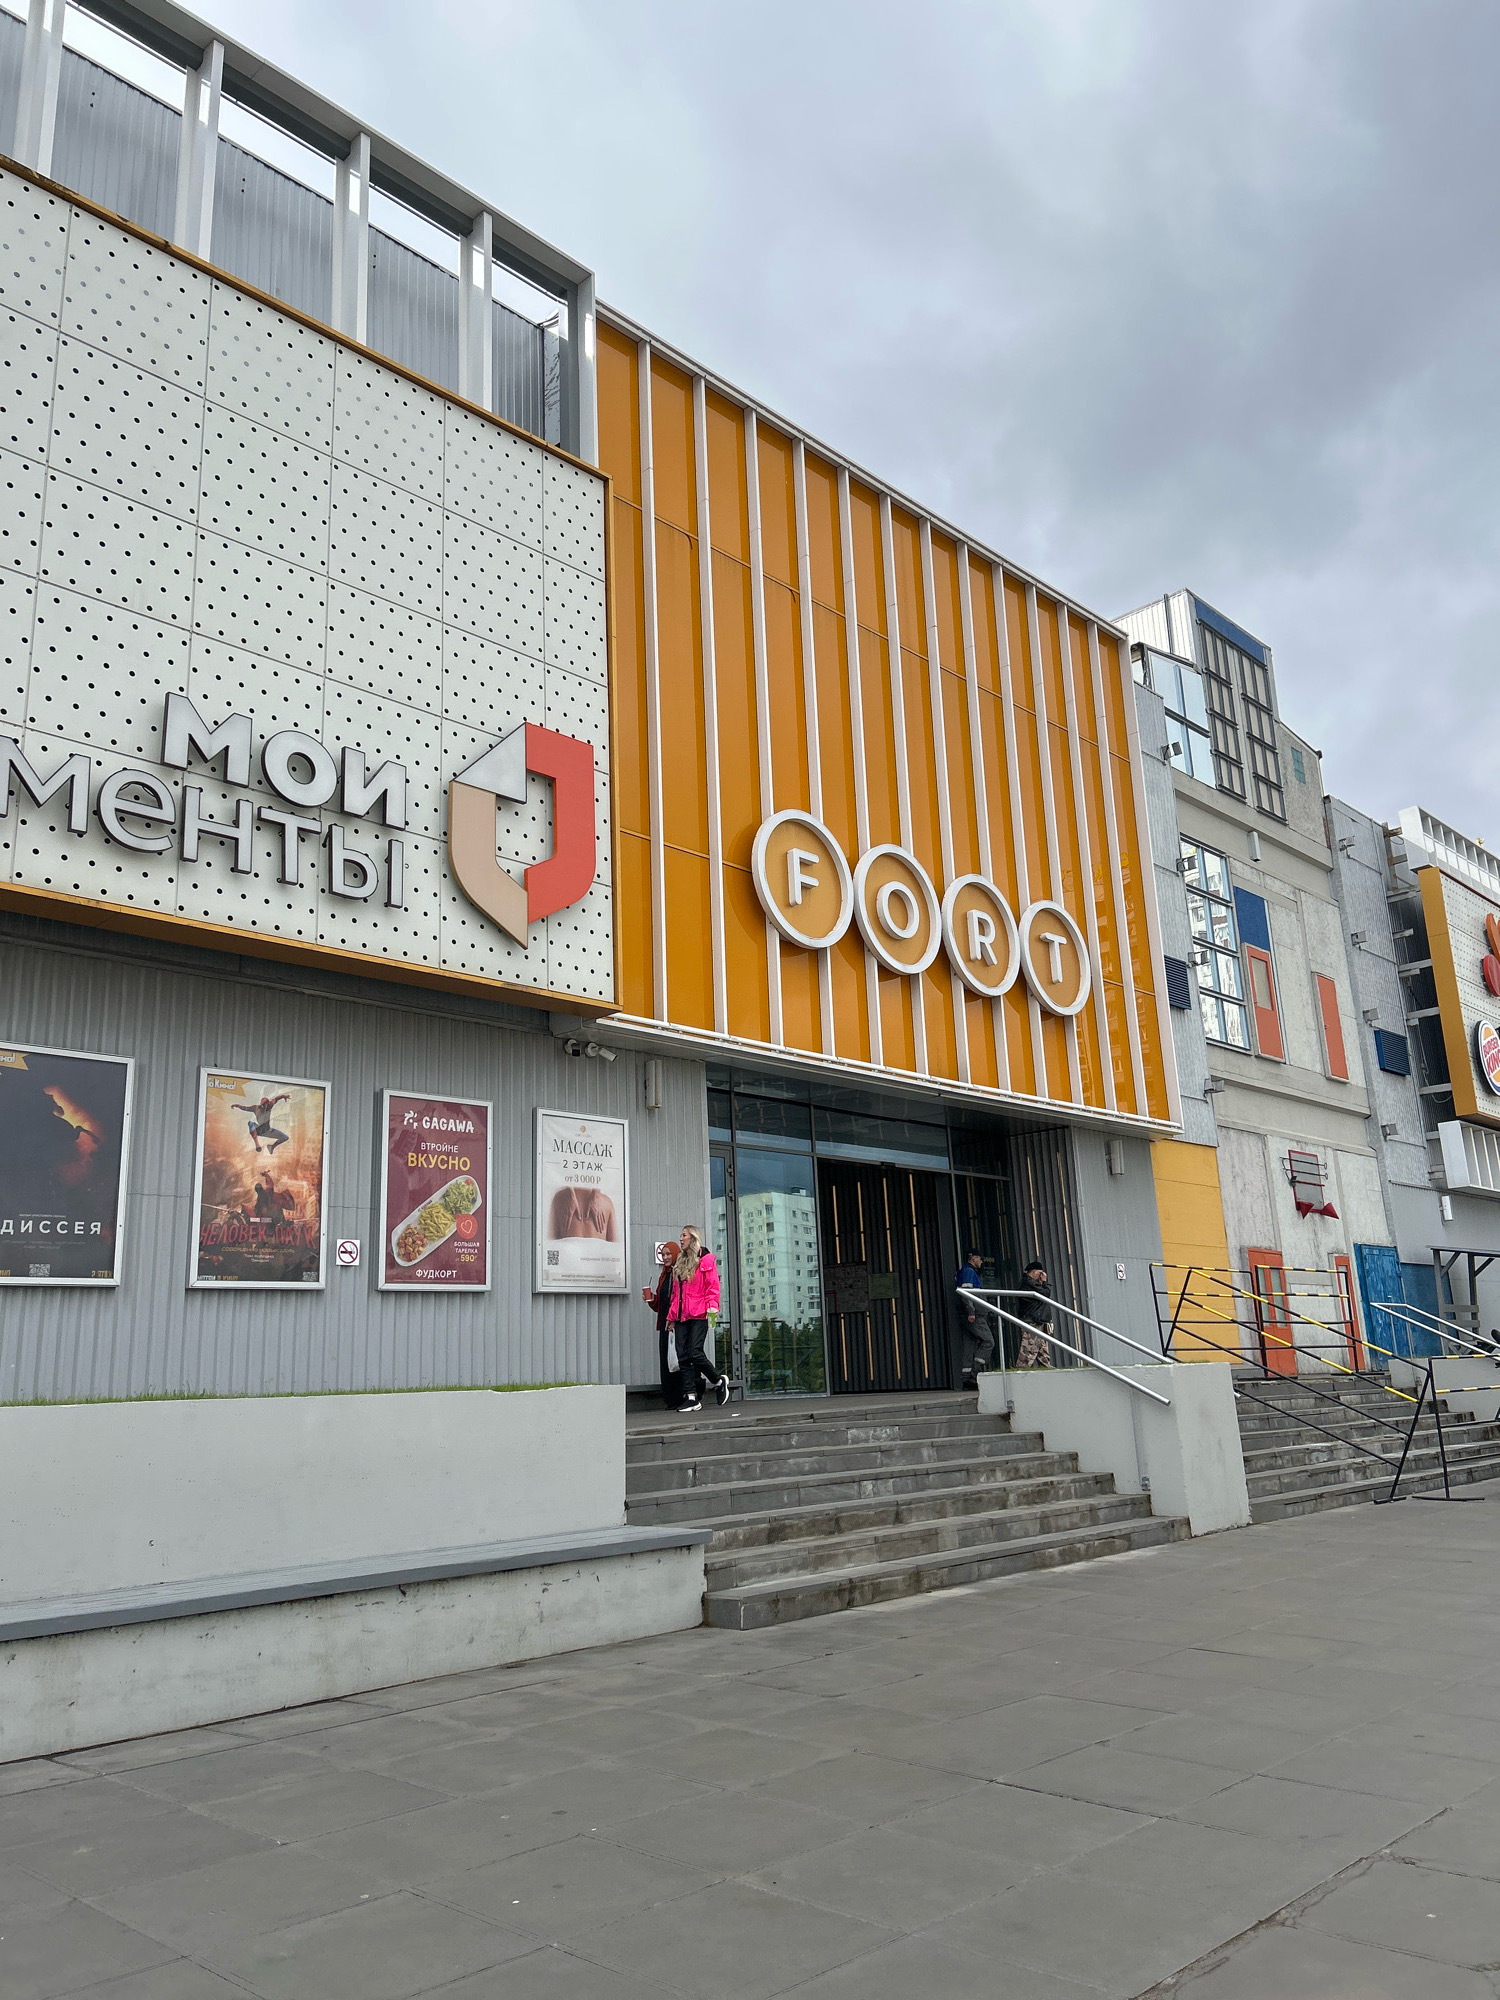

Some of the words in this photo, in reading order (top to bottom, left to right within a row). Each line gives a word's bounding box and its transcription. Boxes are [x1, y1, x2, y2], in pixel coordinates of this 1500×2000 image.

[786, 848, 1068, 984] FORT
[422, 1116, 475, 1134] GAGAWA
[421, 1142, 459, 1153] ВТРОЙНЕ
[553, 1138, 613, 1158] МАССАЖ
[407, 1152, 471, 1171] ВКУСНО
[563, 1159, 568, 1169] 2
[572, 1160, 603, 1172] ЭТАЖ
[200, 1222, 317, 1251] ЧЕЛОВЕК-ПАУК
[415, 1269, 458, 1279] ФУДКОРТ
